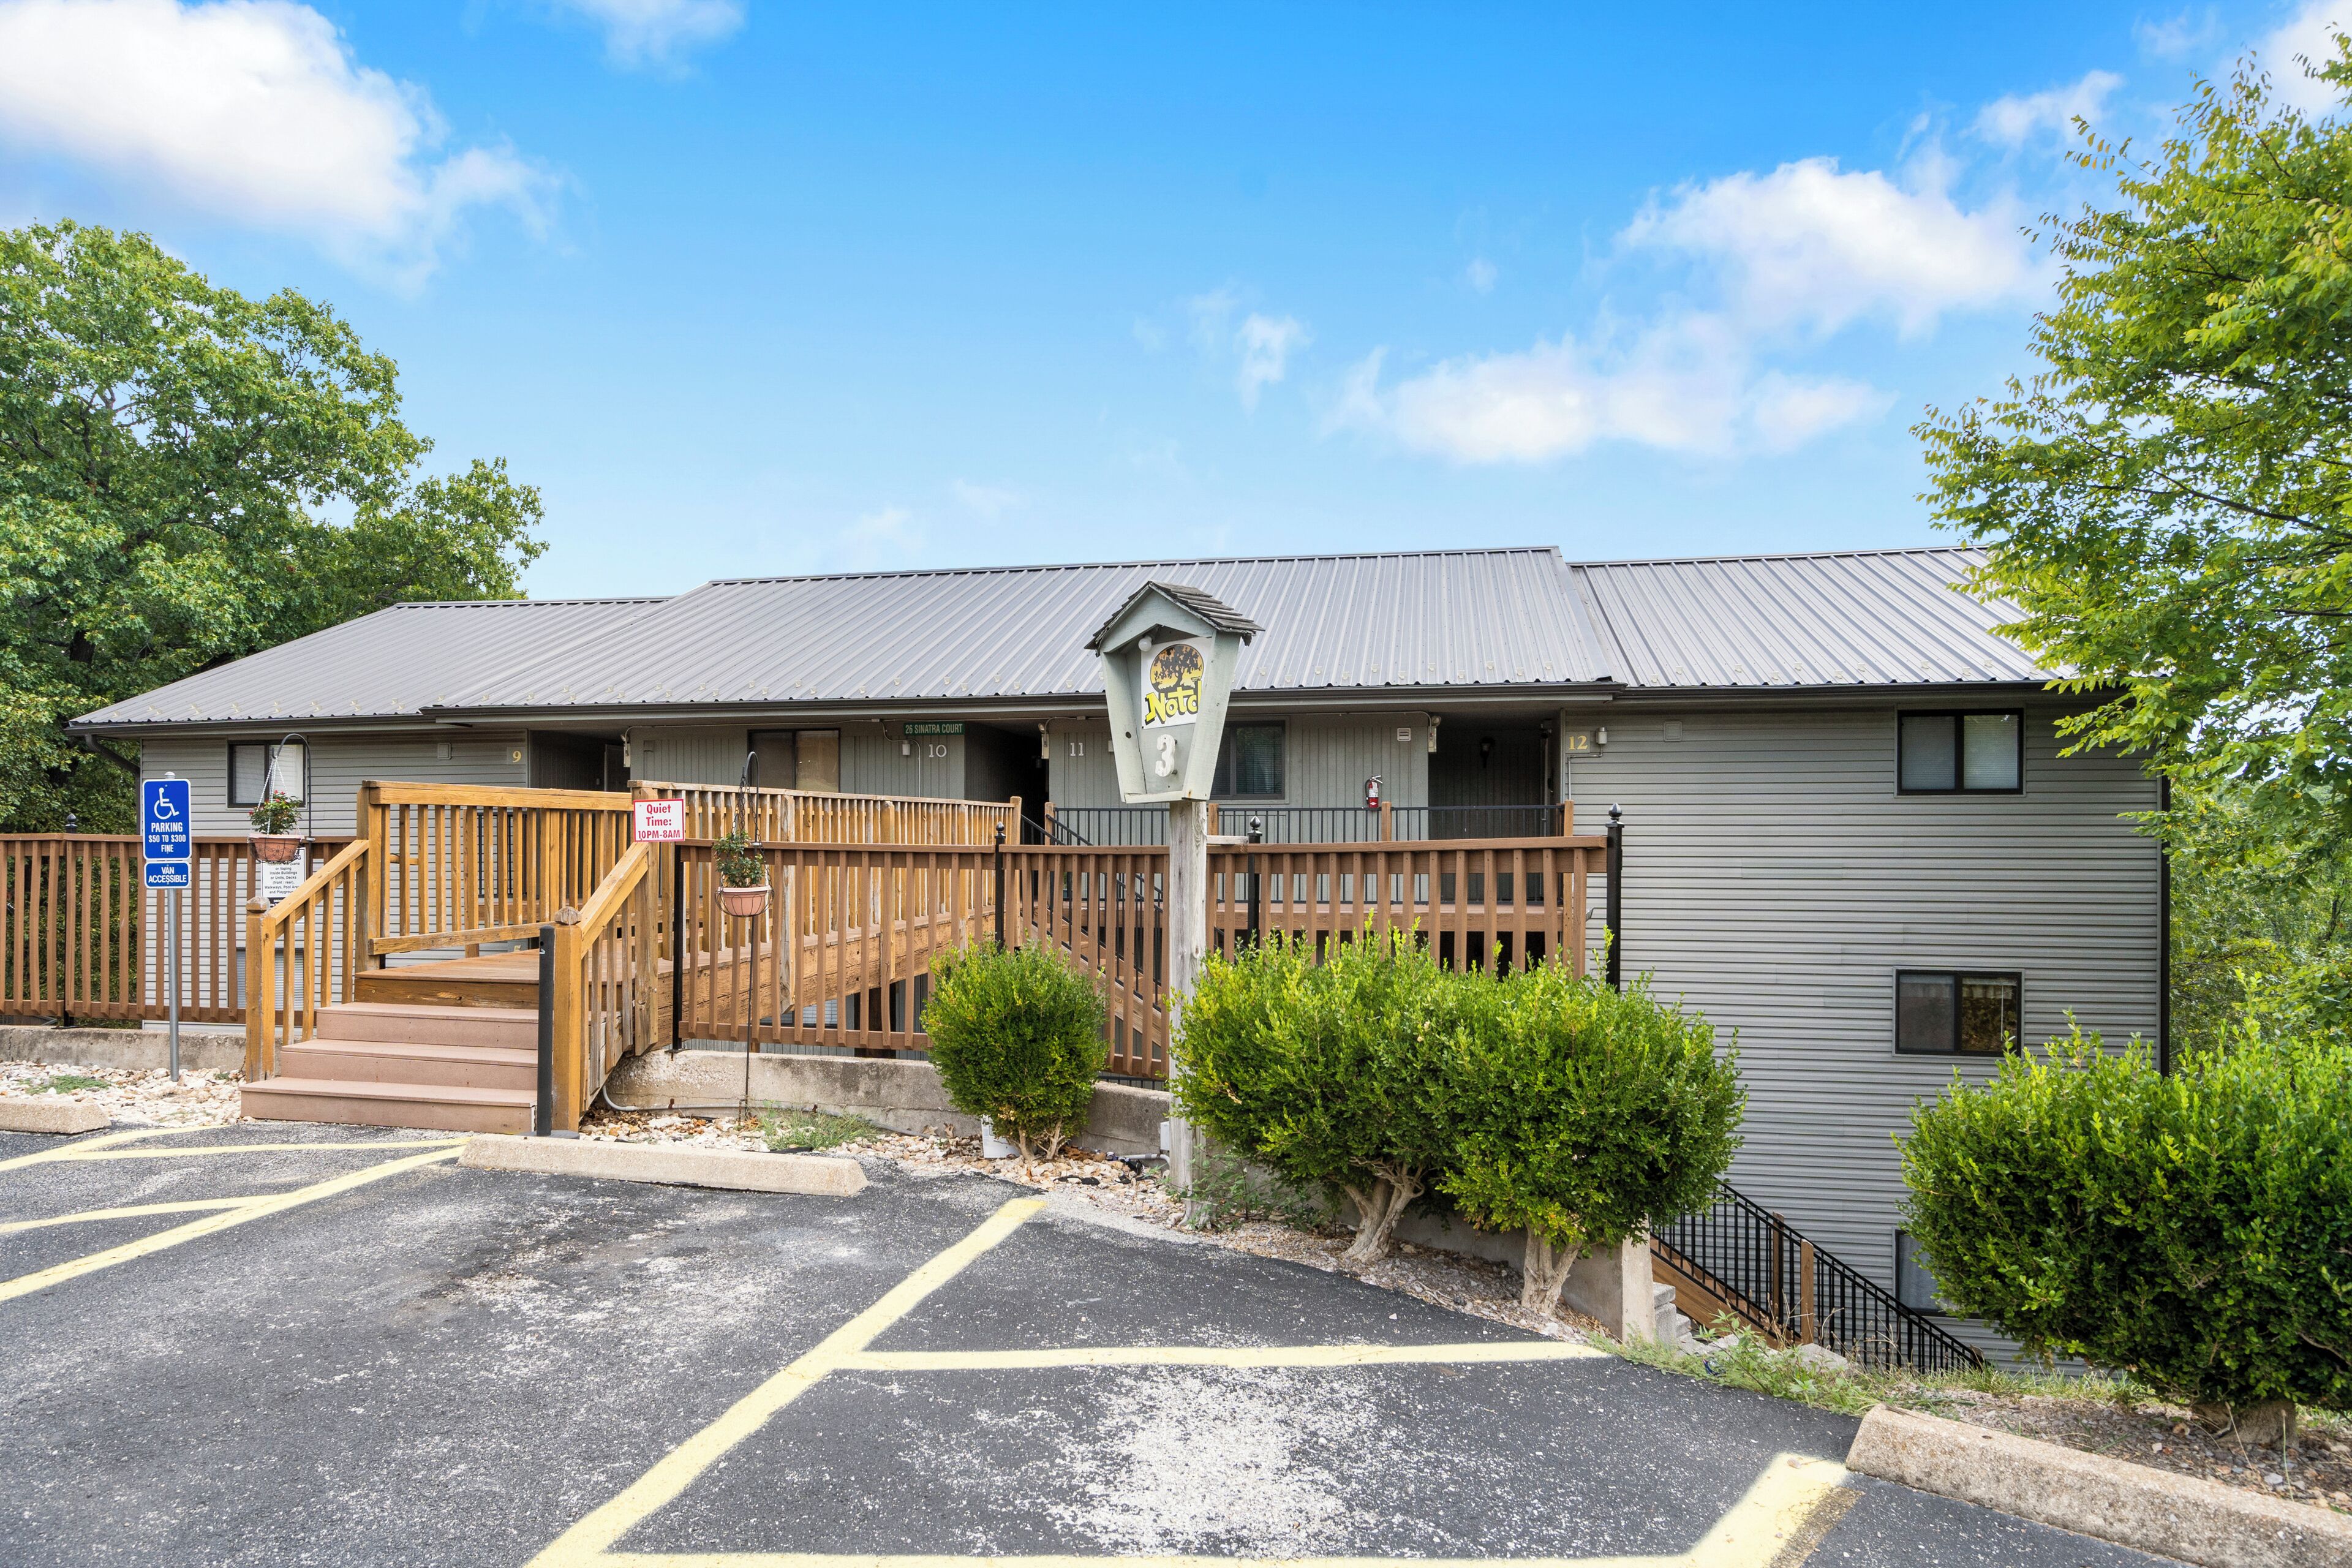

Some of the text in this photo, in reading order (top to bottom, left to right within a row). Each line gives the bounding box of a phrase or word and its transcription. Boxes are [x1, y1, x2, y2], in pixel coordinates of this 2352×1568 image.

[905, 723, 963, 734] 26 SINATRA COURT
[1568, 735, 1588, 750] 12
[929, 744, 947, 758] 10
[1069, 742, 1084, 756] 11
[512, 750, 522, 763] 9
[1155, 734, 1176, 777] 3
[646, 803, 671, 815] Quiet
[151, 822, 183, 832] PARKING
[646, 816, 672, 826] Time:
[171, 834, 186, 843] $300
[638, 829, 680, 839] 10PM-8AM
